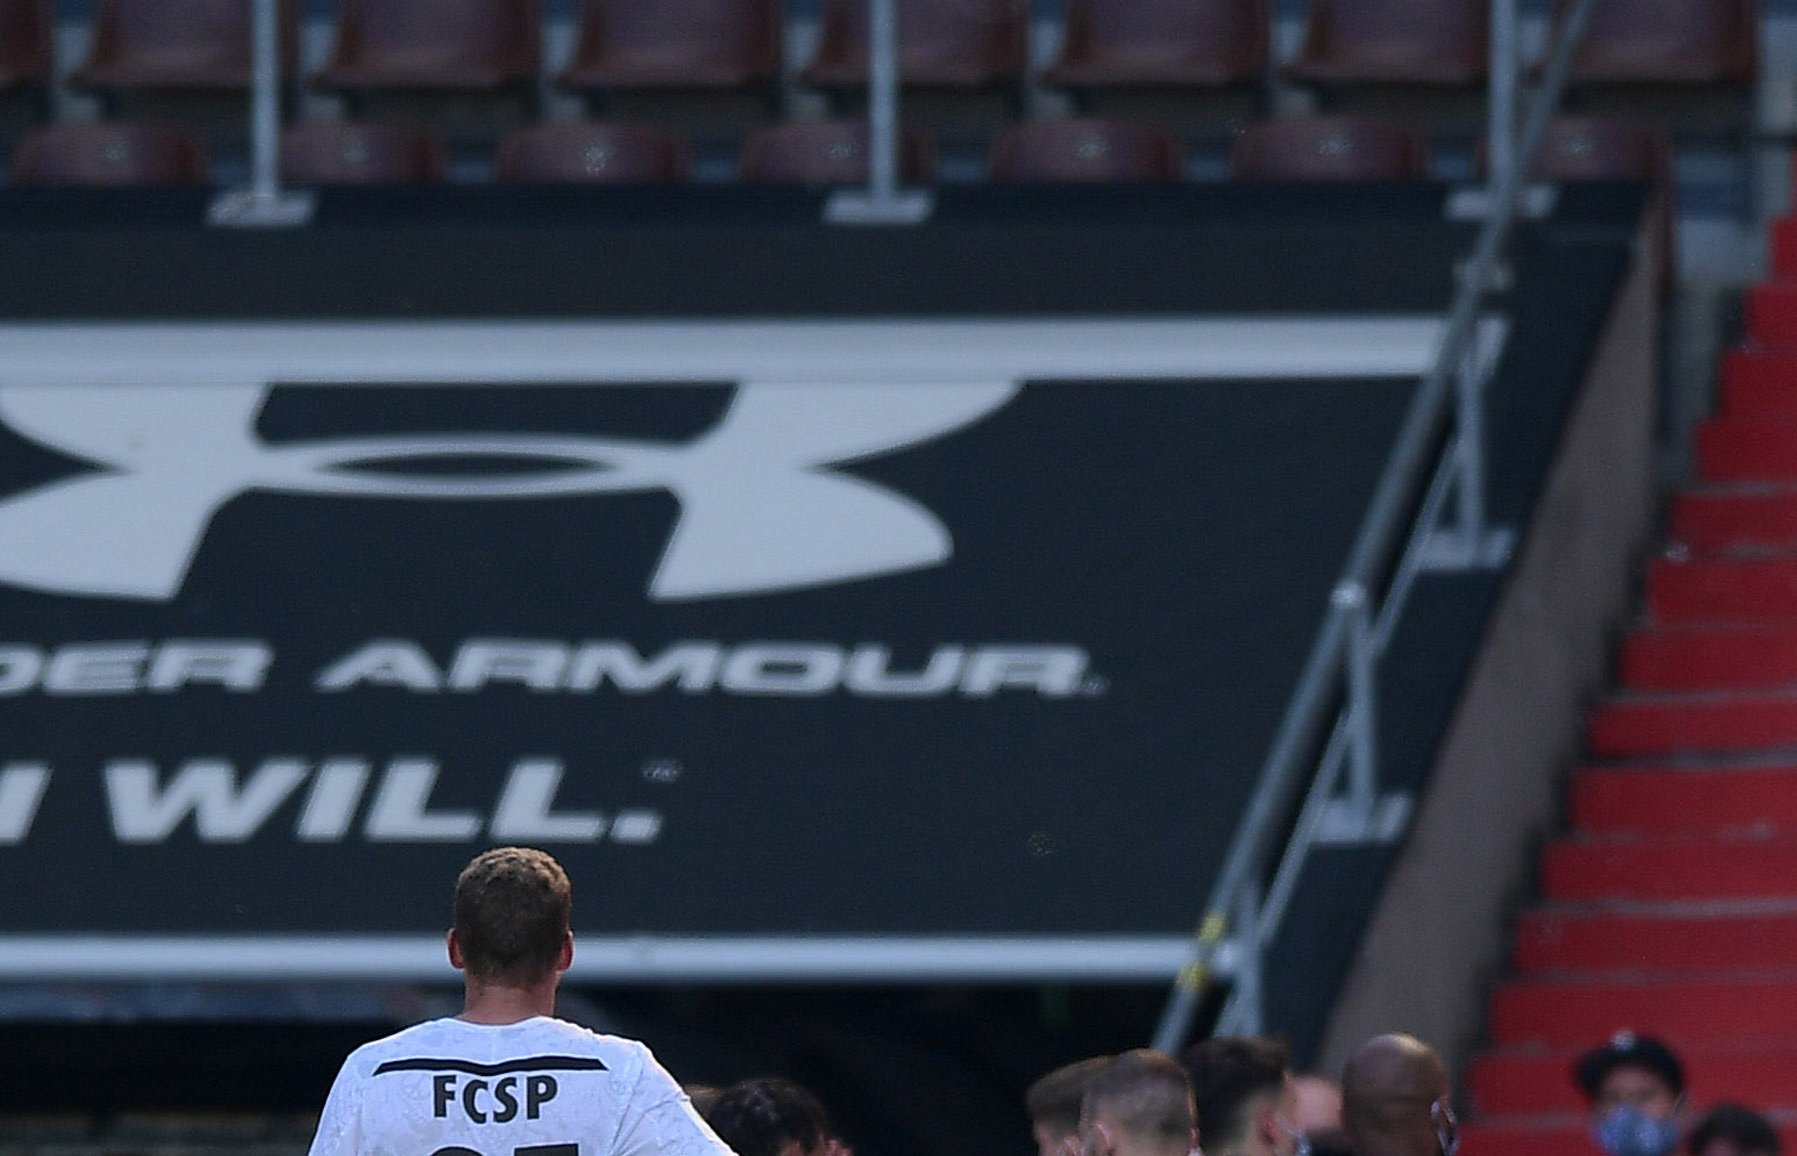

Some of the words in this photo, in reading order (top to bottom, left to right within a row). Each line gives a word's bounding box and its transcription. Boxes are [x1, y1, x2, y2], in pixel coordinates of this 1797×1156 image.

[314, 640, 1090, 698] ARMOUR
[105, 758, 664, 845] WILL.
[433, 1075, 558, 1124] FCSP
